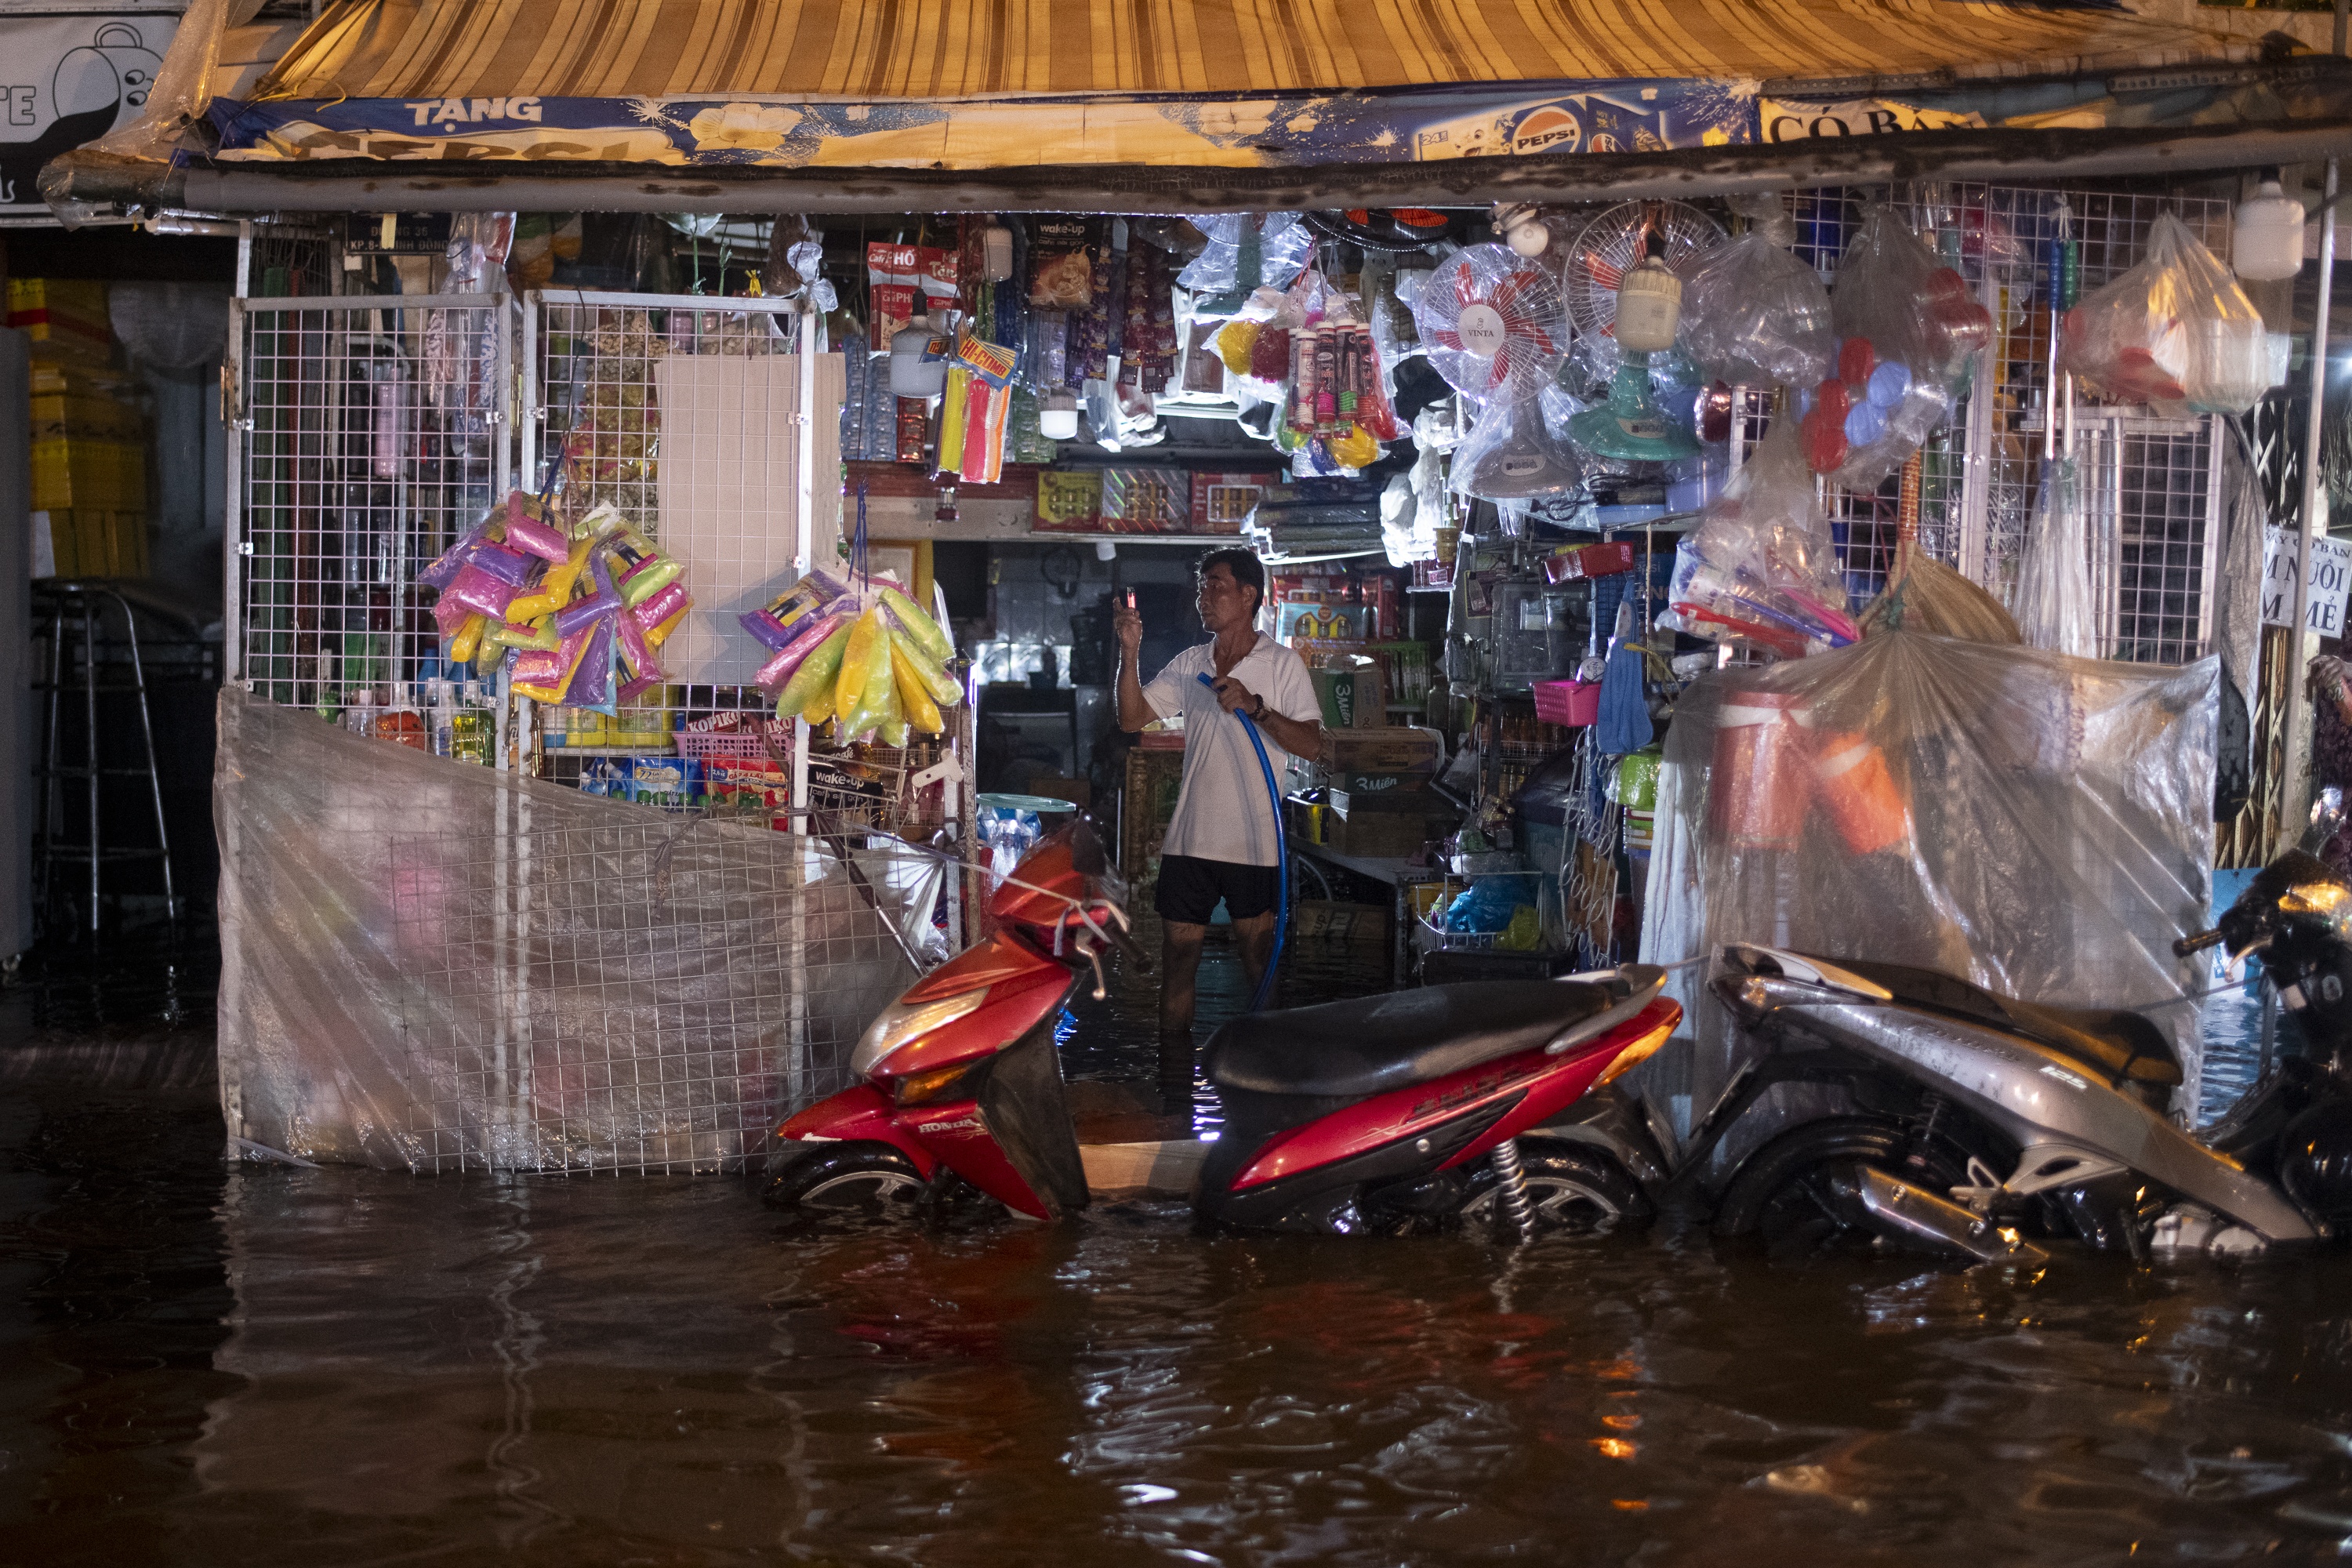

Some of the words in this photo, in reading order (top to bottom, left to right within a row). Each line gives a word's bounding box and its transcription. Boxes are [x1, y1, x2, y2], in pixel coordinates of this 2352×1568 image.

[0, 85, 36, 125] E
[1516, 129, 1576, 150] PEPSI
[959, 338, 1007, 377] HI-COMB
[688, 711, 740, 733] KOPIKO
[639, 769, 652, 780] 72
[2038, 1065, 2087, 1091] 125
[918, 1118, 982, 1134] HONDA
